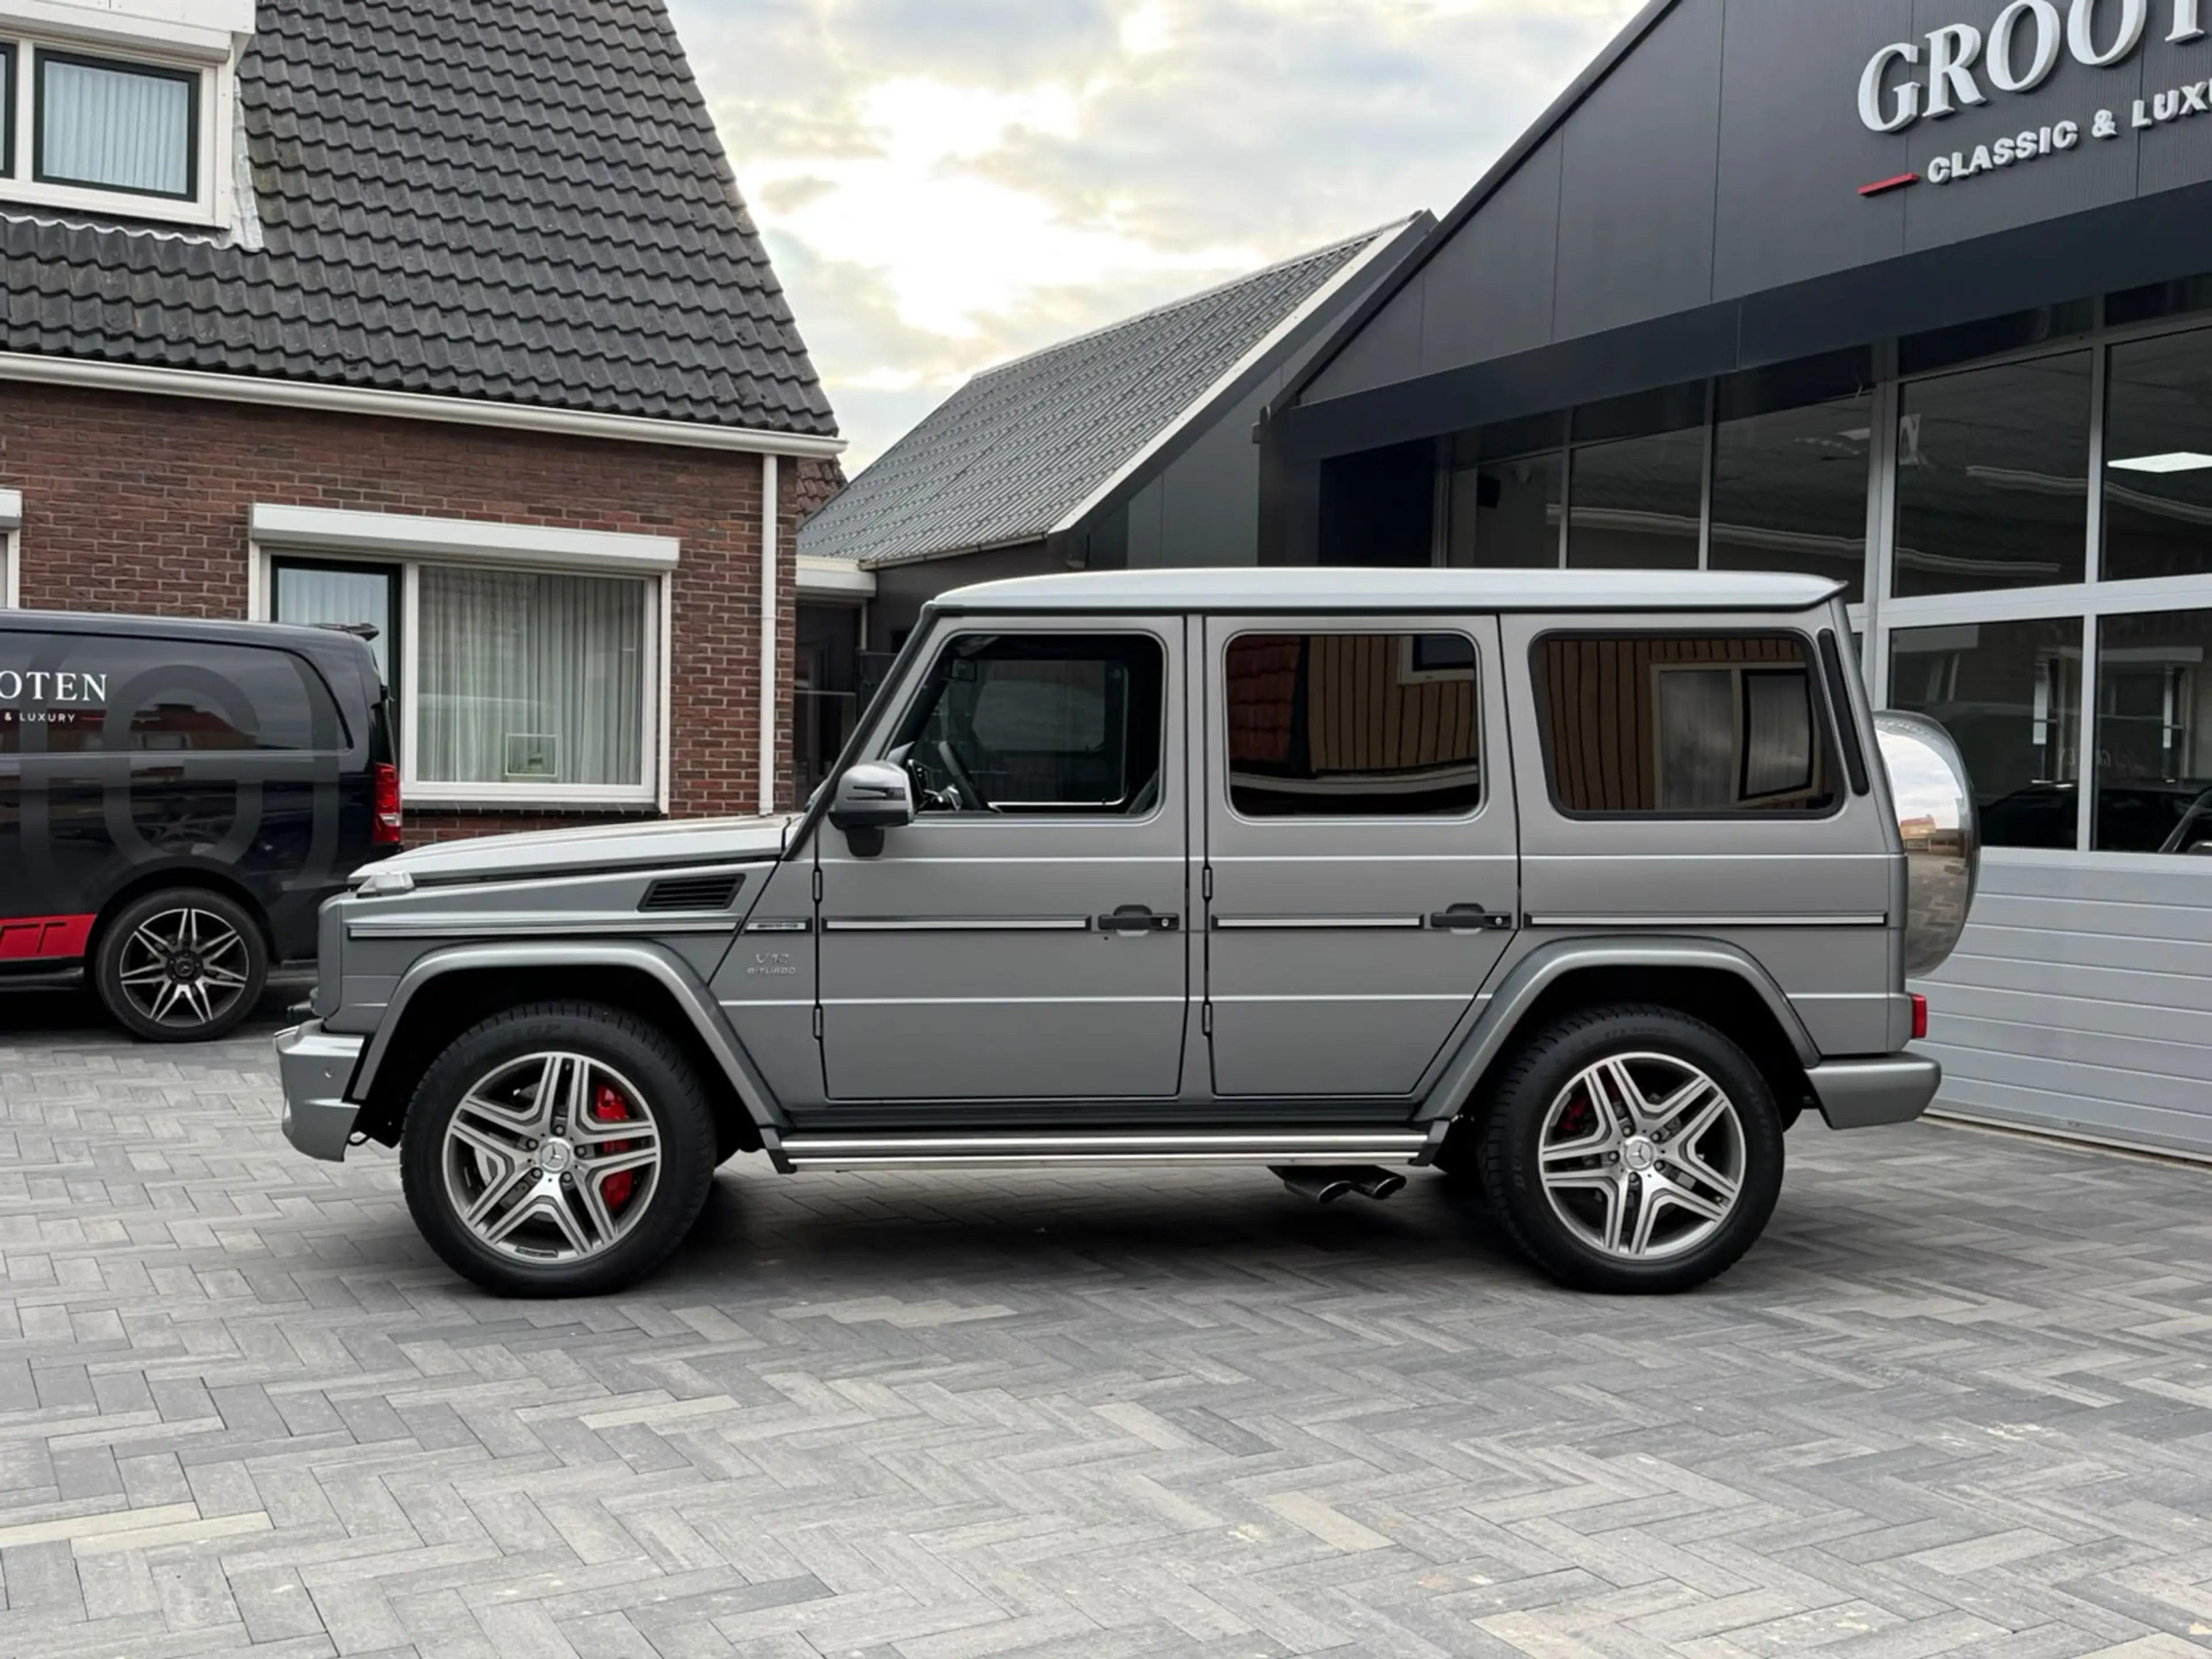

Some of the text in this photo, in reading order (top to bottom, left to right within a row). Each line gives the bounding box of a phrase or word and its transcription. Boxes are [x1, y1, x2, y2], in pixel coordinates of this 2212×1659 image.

[1927, 78, 2212, 184] CLASSIC & LUX
[0, 670, 108, 702] OTEN
[4, 712, 75, 723] & LUXURY
